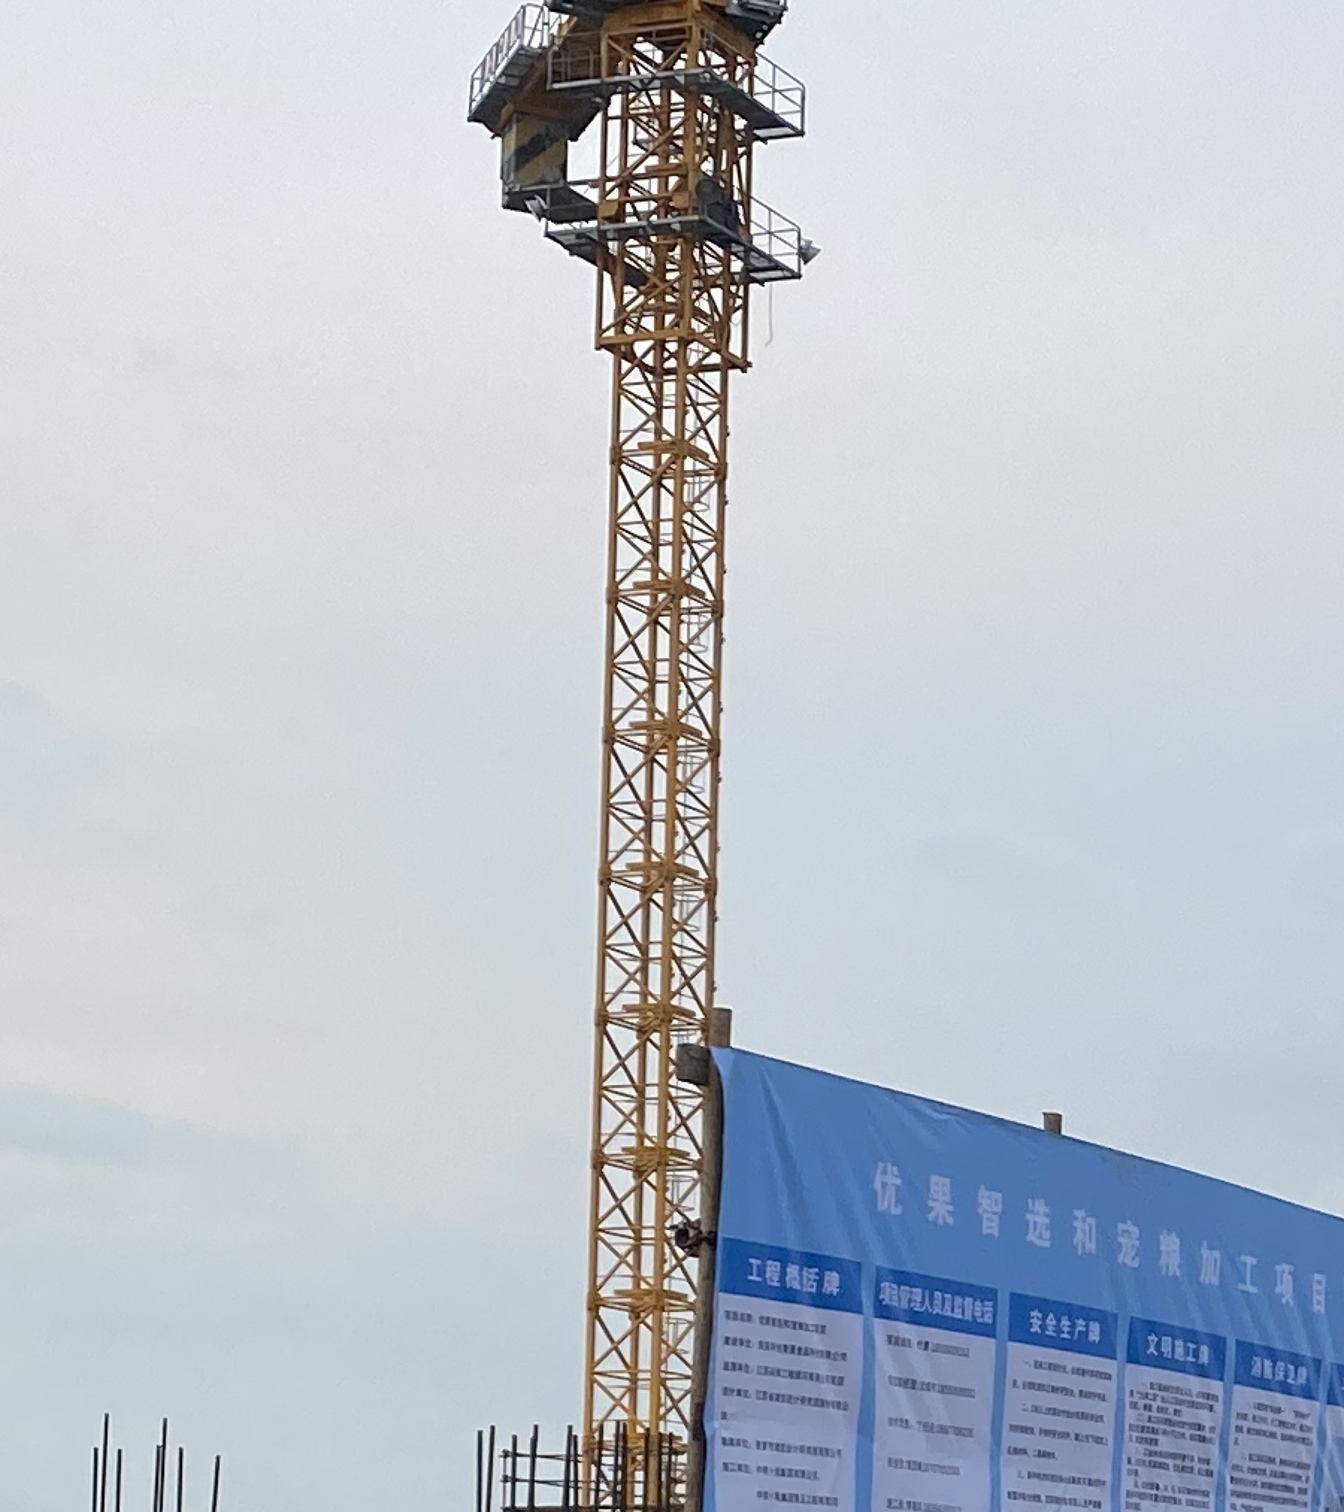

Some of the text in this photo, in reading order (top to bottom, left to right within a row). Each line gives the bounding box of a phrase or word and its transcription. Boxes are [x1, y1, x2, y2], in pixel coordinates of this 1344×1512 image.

[873, 1161, 1327, 1315] 优果智选和宠粮加工项目
[1029, 1308, 1101, 1345] 安全生产牌
[1146, 1332, 1209, 1367] 文明施工牌
